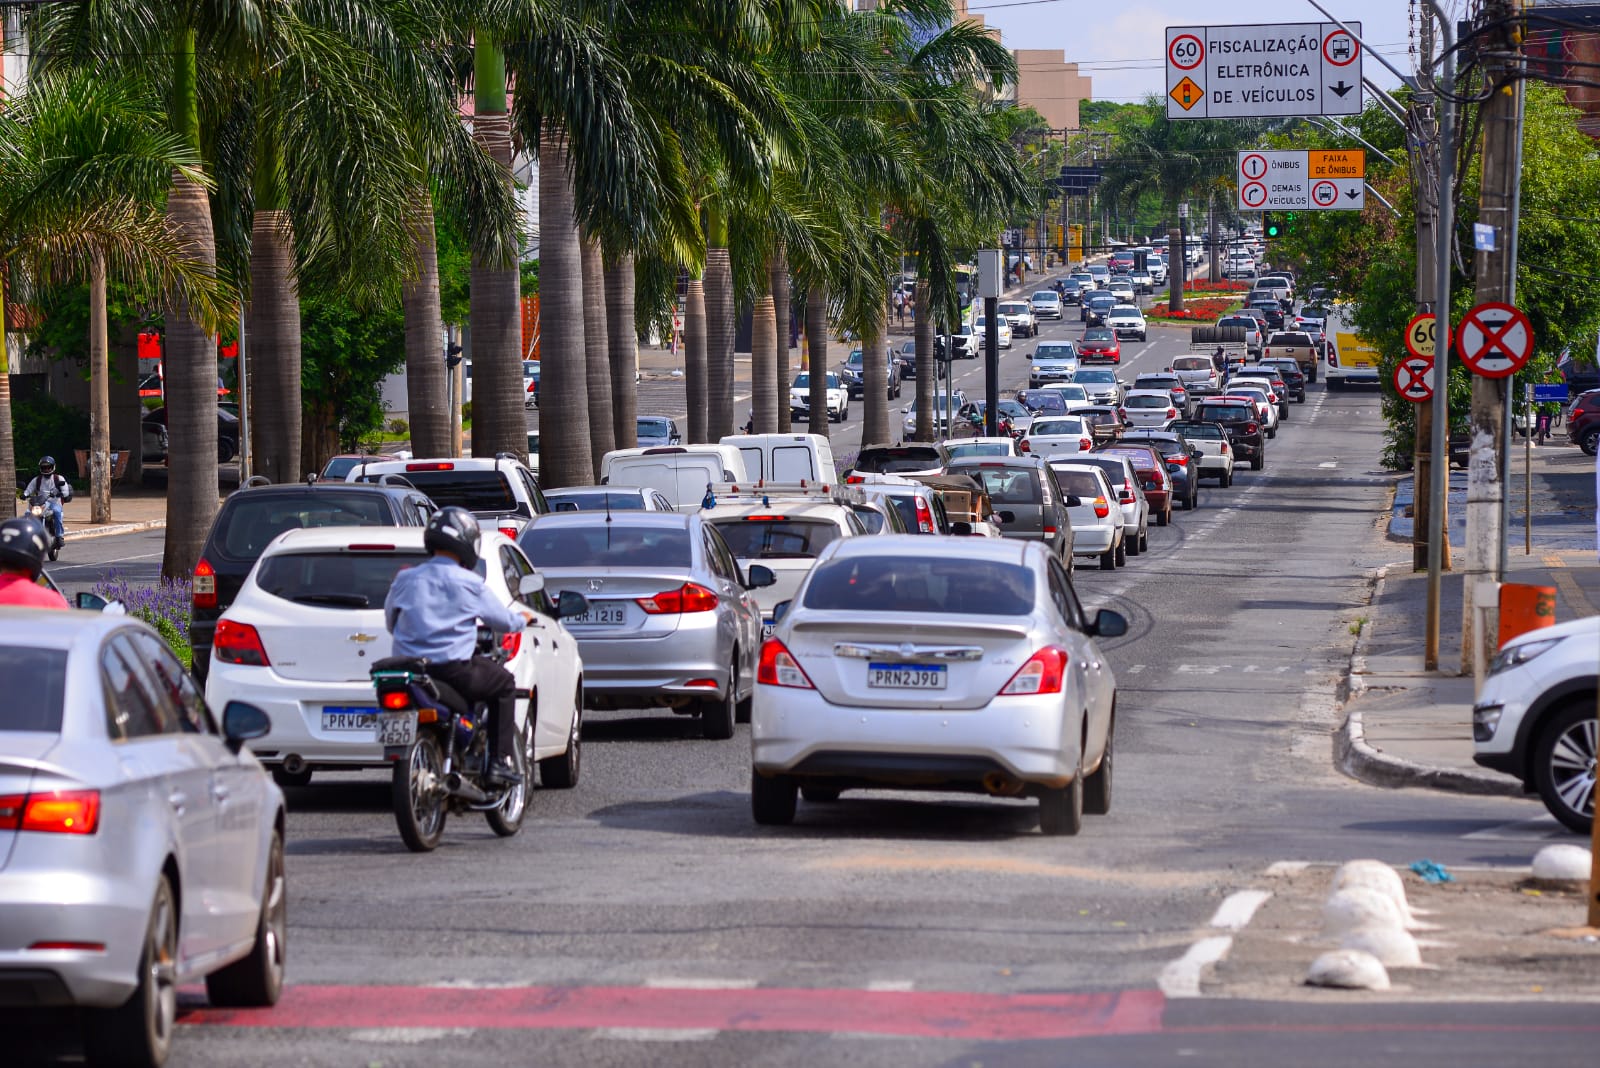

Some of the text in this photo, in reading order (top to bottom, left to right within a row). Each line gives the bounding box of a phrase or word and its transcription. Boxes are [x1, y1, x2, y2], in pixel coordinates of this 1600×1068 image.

[1175, 42, 1197, 57] 60
[1217, 61, 1310, 79] ELETRÔNICA
[1213, 85, 1316, 104] DE VEÍCULOS
[1323, 155, 1348, 163] FAIXA
[1271, 161, 1300, 169] ÔNIBUS
[1315, 164, 1357, 174] DE ÔNIBUS
[1271, 184, 1302, 193] DEMAIS
[1268, 196, 1307, 205] VEÍCULOS
[875, 671, 939, 686] PRN2J90
[379, 732, 410, 744] 4620
